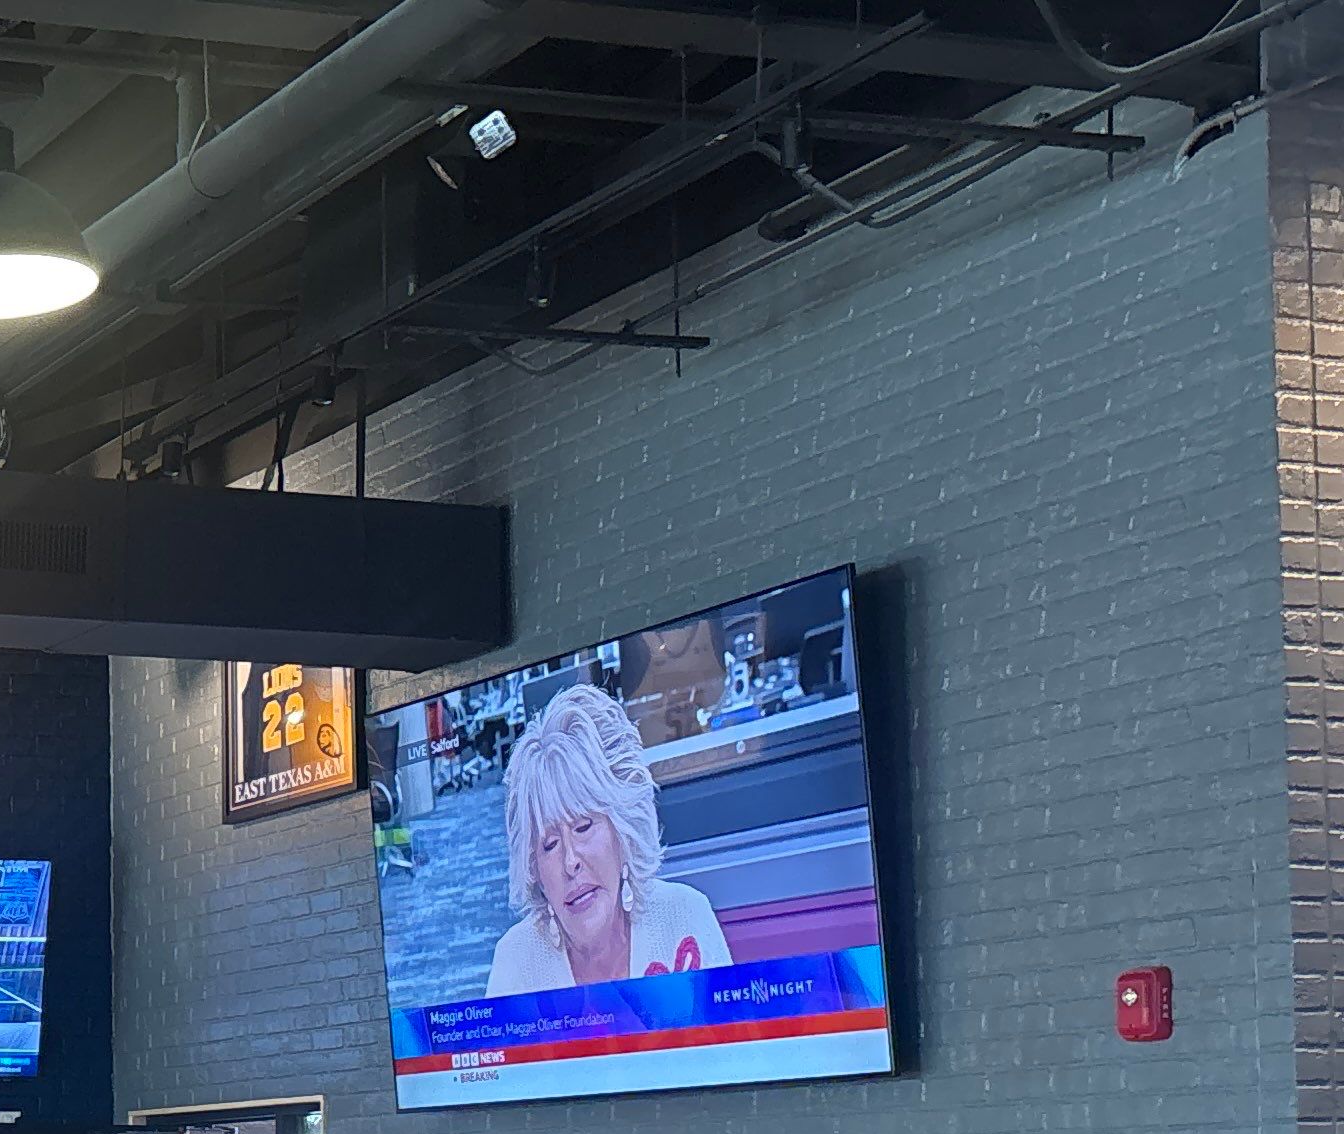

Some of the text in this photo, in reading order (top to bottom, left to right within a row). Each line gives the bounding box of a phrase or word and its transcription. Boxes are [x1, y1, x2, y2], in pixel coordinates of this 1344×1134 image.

[263, 692, 305, 753] 22
[408, 734, 460, 760] LIVE Salford
[235, 756, 346, 803] EAST TEXAS A&M
[714, 988, 750, 1003] NEWS
[769, 980, 813, 997] NIGHT
[430, 1006, 494, 1027] Maggie Oliver
[432, 1030, 464, 1043] Founder
[465, 1027, 480, 1038] and
[506, 1022, 536, 1037] Maggie
[537, 1018, 563, 1032] Oliver
[564, 1012, 615, 1028] Foundation
[480, 1050, 506, 1063] NEWS
[460, 1070, 499, 1083] BREAKING
